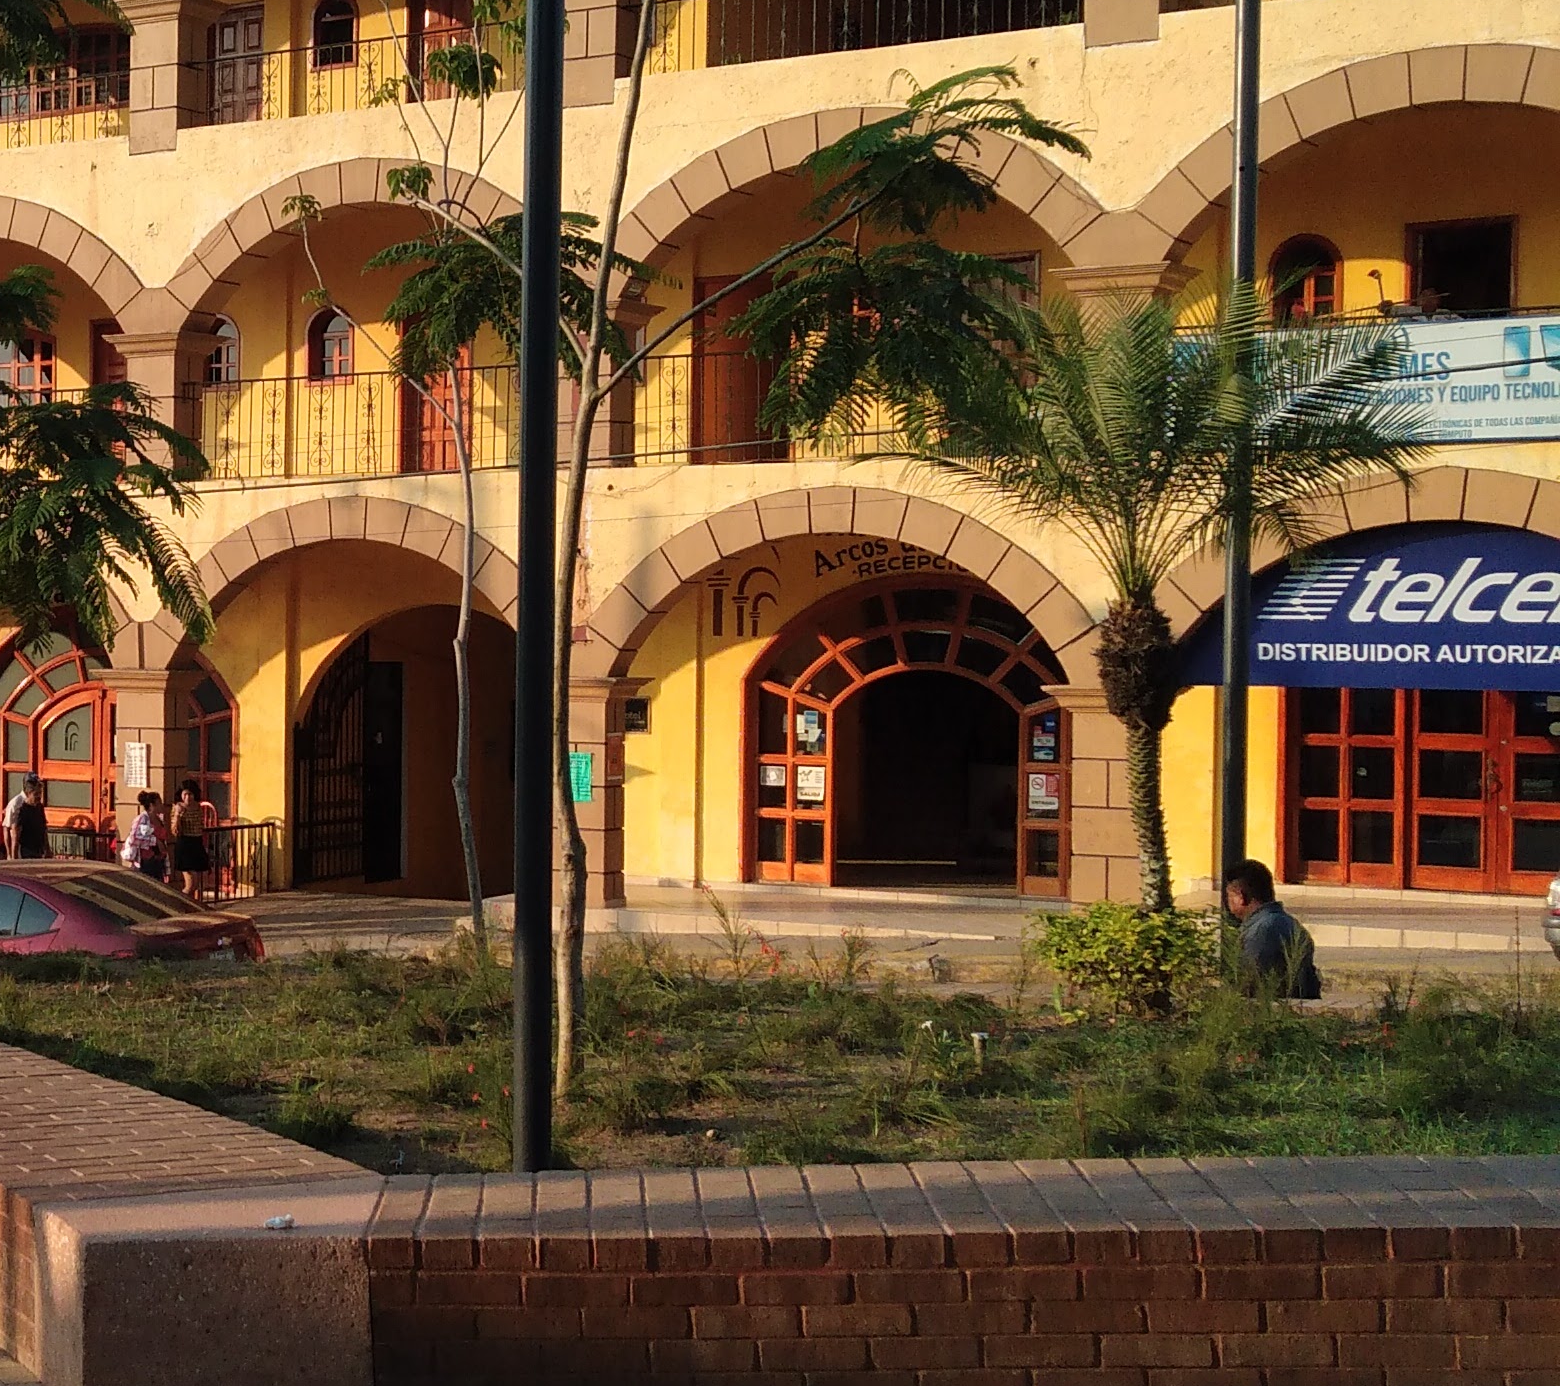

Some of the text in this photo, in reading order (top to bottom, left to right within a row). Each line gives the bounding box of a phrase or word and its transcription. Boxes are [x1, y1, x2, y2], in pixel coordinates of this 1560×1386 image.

[1450, 384, 1500, 403] EQUIPO
[1504, 381, 1560, 400] TECNOL
[815, 538, 889, 577] Arcos
[1257, 642, 1431, 663] DISTRIBUIDOR
